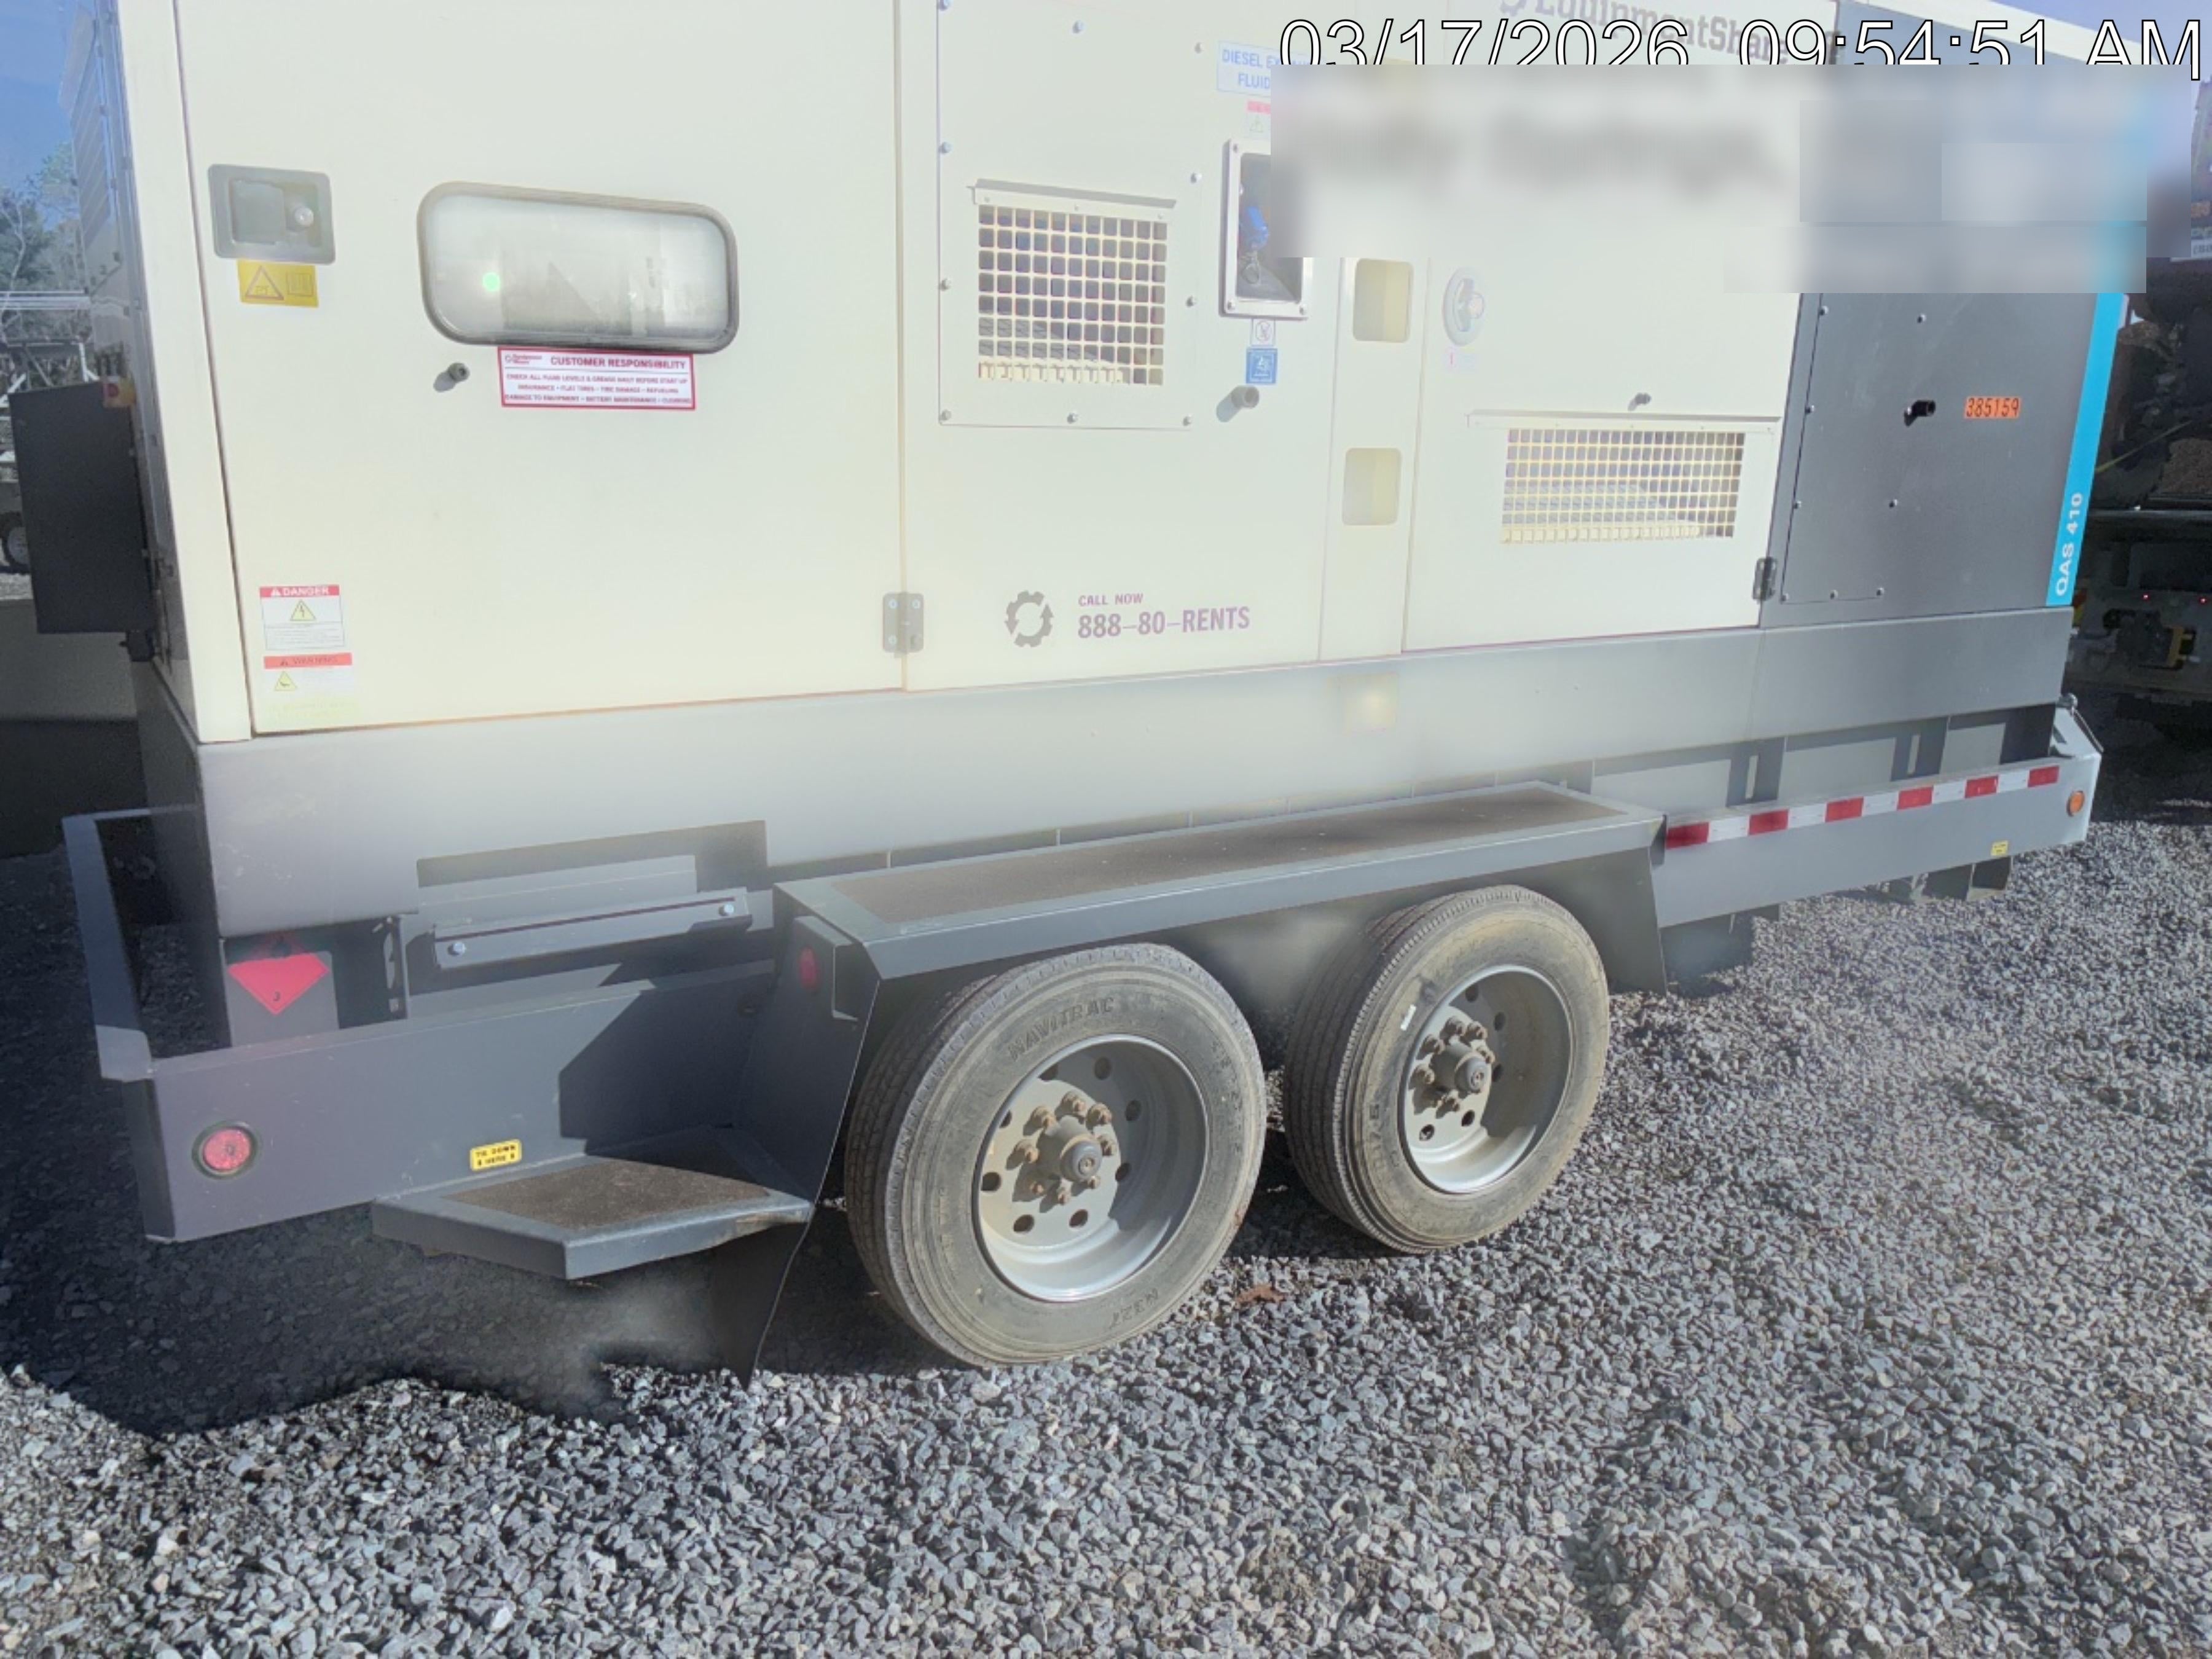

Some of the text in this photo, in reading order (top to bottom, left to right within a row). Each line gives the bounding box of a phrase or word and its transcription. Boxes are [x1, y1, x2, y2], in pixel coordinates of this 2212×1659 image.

[1222, 48, 1262, 69] DIESEL
[551, 356, 605, 367] CUSTOMER
[608, 358, 685, 369] RESPONSIBILITY
[1967, 397, 2020, 418] 385159
[2066, 493, 2083, 535] 410
[283, 586, 330, 597] DANGER
[1078, 592, 1143, 606] CALL NOW
[1008, 997, 1115, 1062] NAVITRAC
